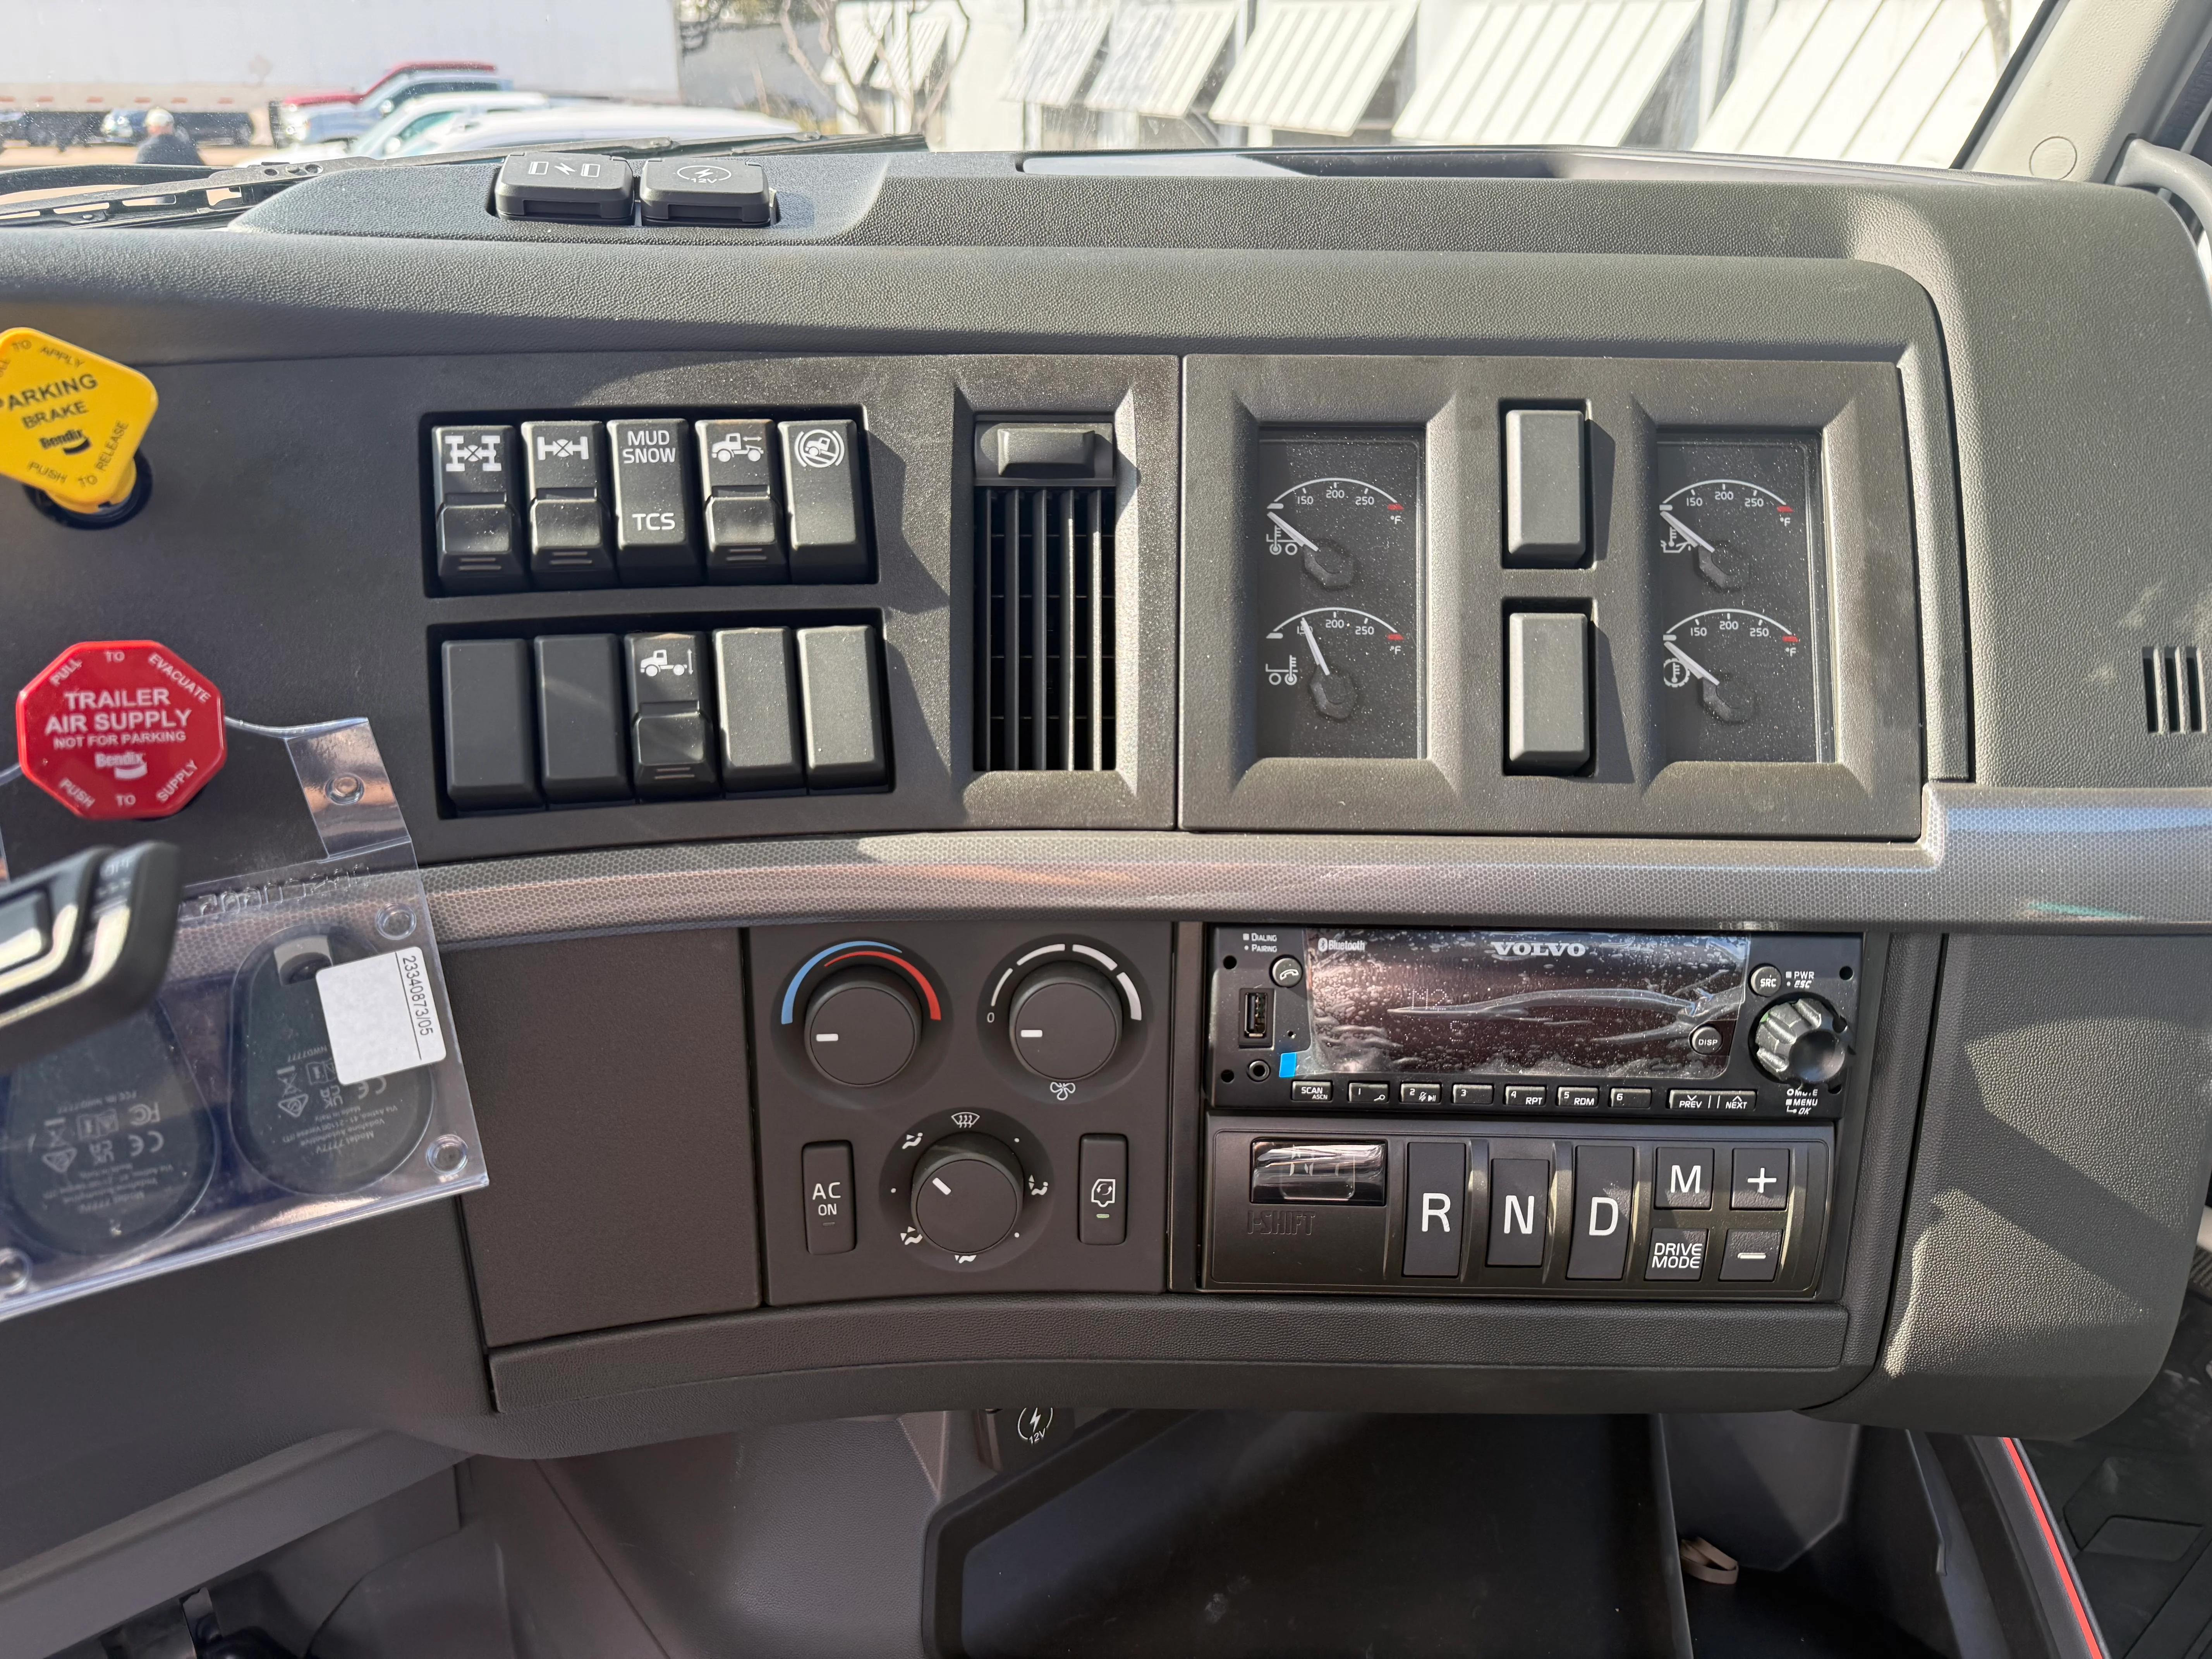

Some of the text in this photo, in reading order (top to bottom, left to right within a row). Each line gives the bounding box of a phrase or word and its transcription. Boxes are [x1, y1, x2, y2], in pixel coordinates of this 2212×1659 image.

[41, 346, 85, 369] APPLY
[22, 400, 89, 429] BRAKE
[627, 430, 670, 446] MUD
[28, 419, 129, 488] PUSH TO RELEASE
[622, 447, 676, 464] SNOW
[1298, 490, 1374, 505] 150 200 250
[1686, 491, 1764, 507] 150 200 250
[632, 513, 675, 531] TCS
[1326, 620, 1344, 629] 200
[1355, 626, 1374, 635] 250
[1690, 620, 1769, 637] 150 200 250
[49, 651, 211, 704] PULL TO EVACUATE
[65, 688, 170, 710] TRAILER
[45, 709, 192, 735] AIR SUPPLY
[53, 731, 186, 750] NOT FOR PARKING
[95, 751, 146, 768] Bendix
[59, 759, 199, 808] PUSH TO SUPPLY
[1329, 941, 1365, 951] Bluetooth
[1491, 942, 1585, 957] VOLVO
[1760, 979, 1776, 987] SRC
[402, 955, 434, 1036] 23340873/05
[1671, 1165, 1701, 1193] M
[818, 1204, 837, 1216] ON
[1422, 1193, 1451, 1232] R
[1504, 1195, 1535, 1234] N
[1589, 1197, 1618, 1236] D
[1247, 1210, 1315, 1235] I-SHIFT
[1654, 1242, 1702, 1256] DRIVE
[1652, 1256, 1701, 1268] MODE
[1029, 1428, 1046, 1445] 12V
